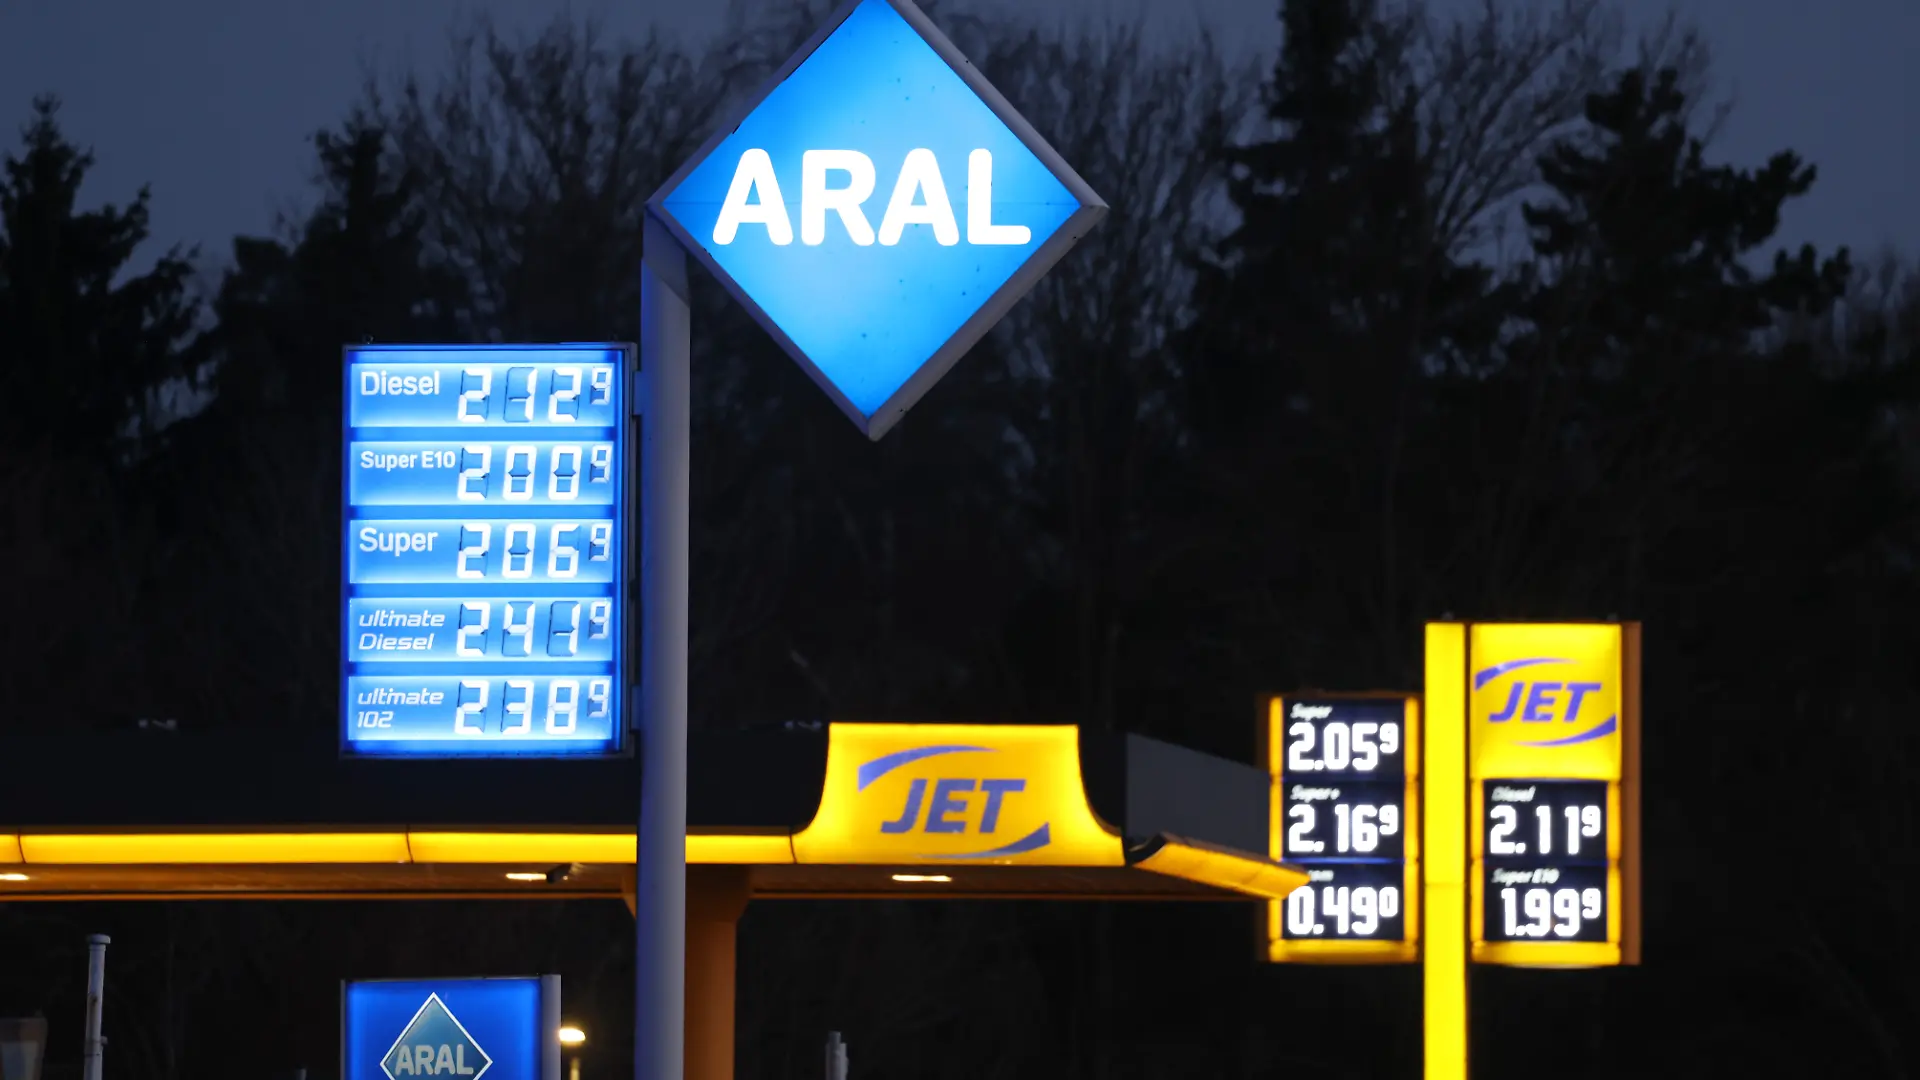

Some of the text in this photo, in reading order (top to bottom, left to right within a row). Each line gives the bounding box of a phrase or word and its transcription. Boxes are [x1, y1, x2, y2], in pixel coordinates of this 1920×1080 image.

[712, 147, 1032, 246] ARAL
[360, 371, 440, 396] Diesel
[360, 451, 417, 472] Super
[421, 451, 455, 468] E10
[359, 527, 438, 557] Super
[359, 609, 445, 627] ultimate
[359, 633, 434, 650] Diesel
[357, 687, 444, 705] ultimate
[1488, 682, 1602, 722] JET
[357, 711, 394, 728] 102
[1288, 722, 1399, 771] 2.059
[881, 779, 1026, 833] JET
[1501, 888, 1602, 937] 1.999
[394, 1044, 474, 1076] ARAL
